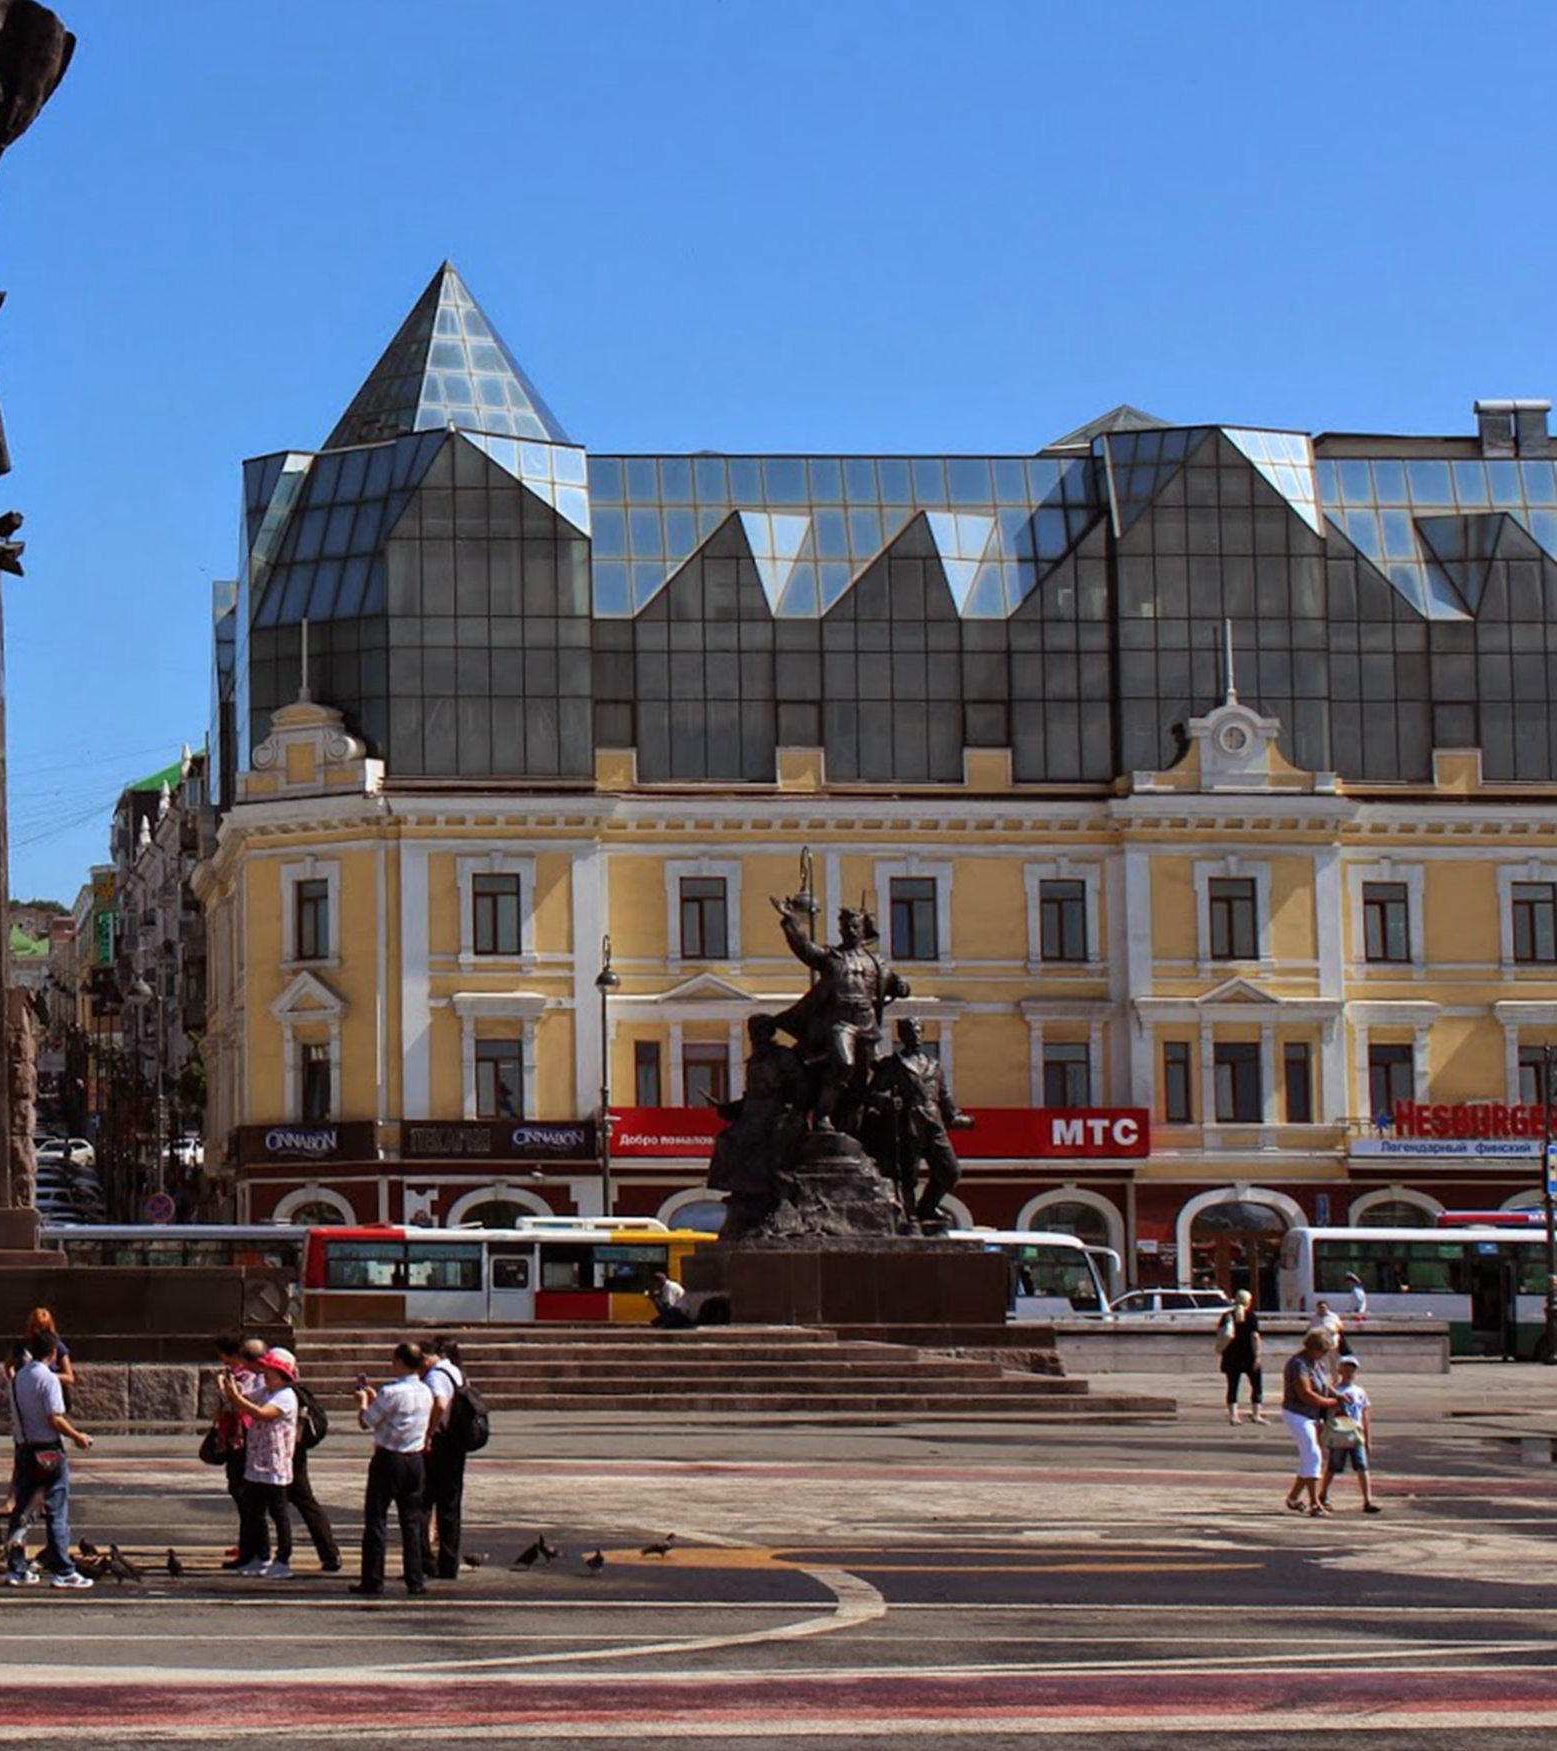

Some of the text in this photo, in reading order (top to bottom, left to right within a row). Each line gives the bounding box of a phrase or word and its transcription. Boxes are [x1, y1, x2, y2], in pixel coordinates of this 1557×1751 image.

[1395, 1100, 1557, 1138] HESBURGE
[265, 1130, 337, 1151] CINNABON
[619, 1134, 715, 1147] Добро пожалов
[1051, 1118, 1139, 1146] МТС
[1474, 1141, 1532, 1154] финский
